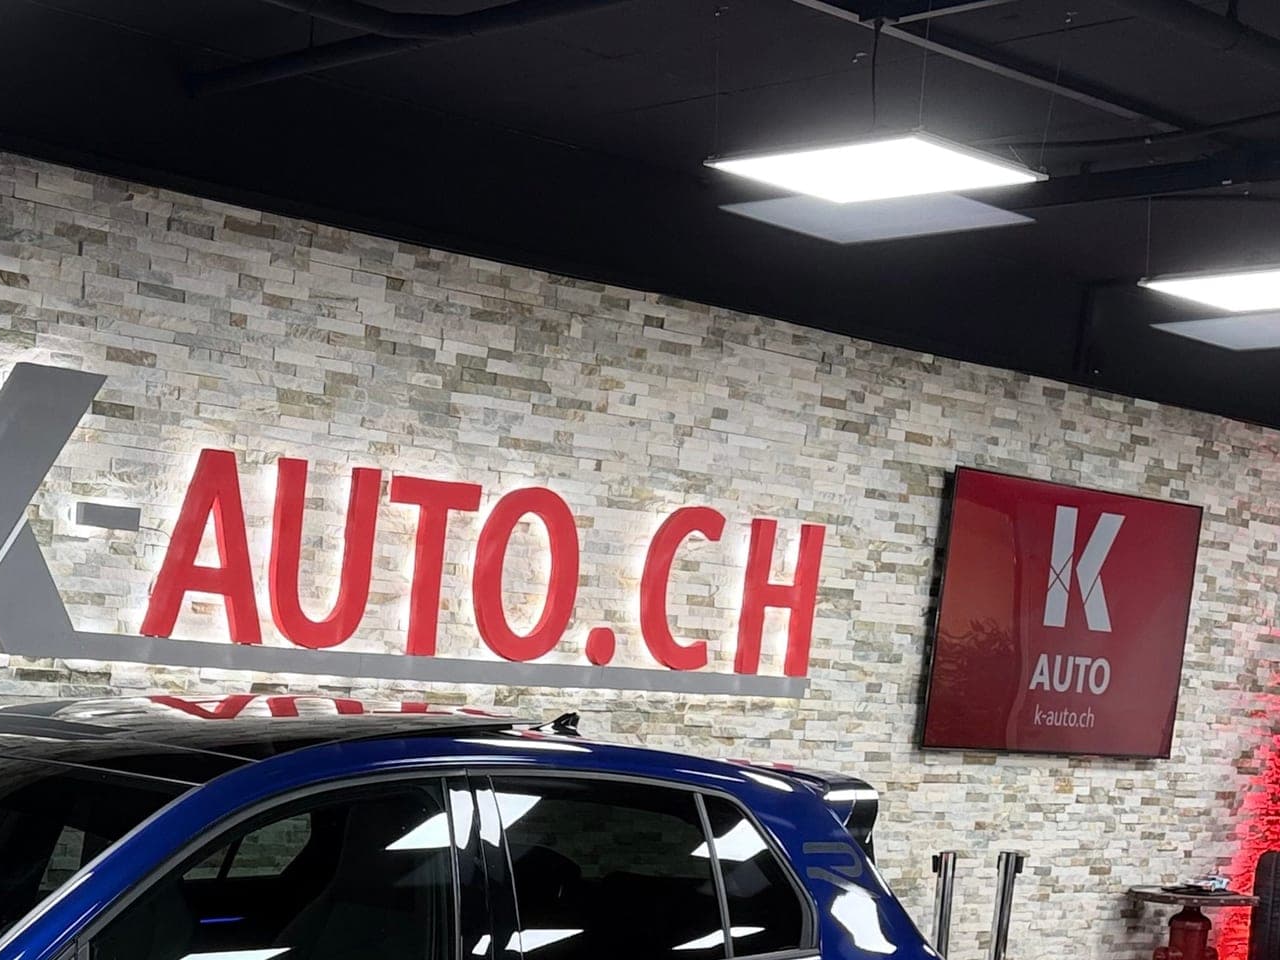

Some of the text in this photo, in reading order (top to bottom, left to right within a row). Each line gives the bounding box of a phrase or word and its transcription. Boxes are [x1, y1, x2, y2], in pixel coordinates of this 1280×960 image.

[1043, 505, 1126, 632] K
[1029, 653, 1111, 695] AUTO
[1034, 704, 1095, 728] k-auto.ch
